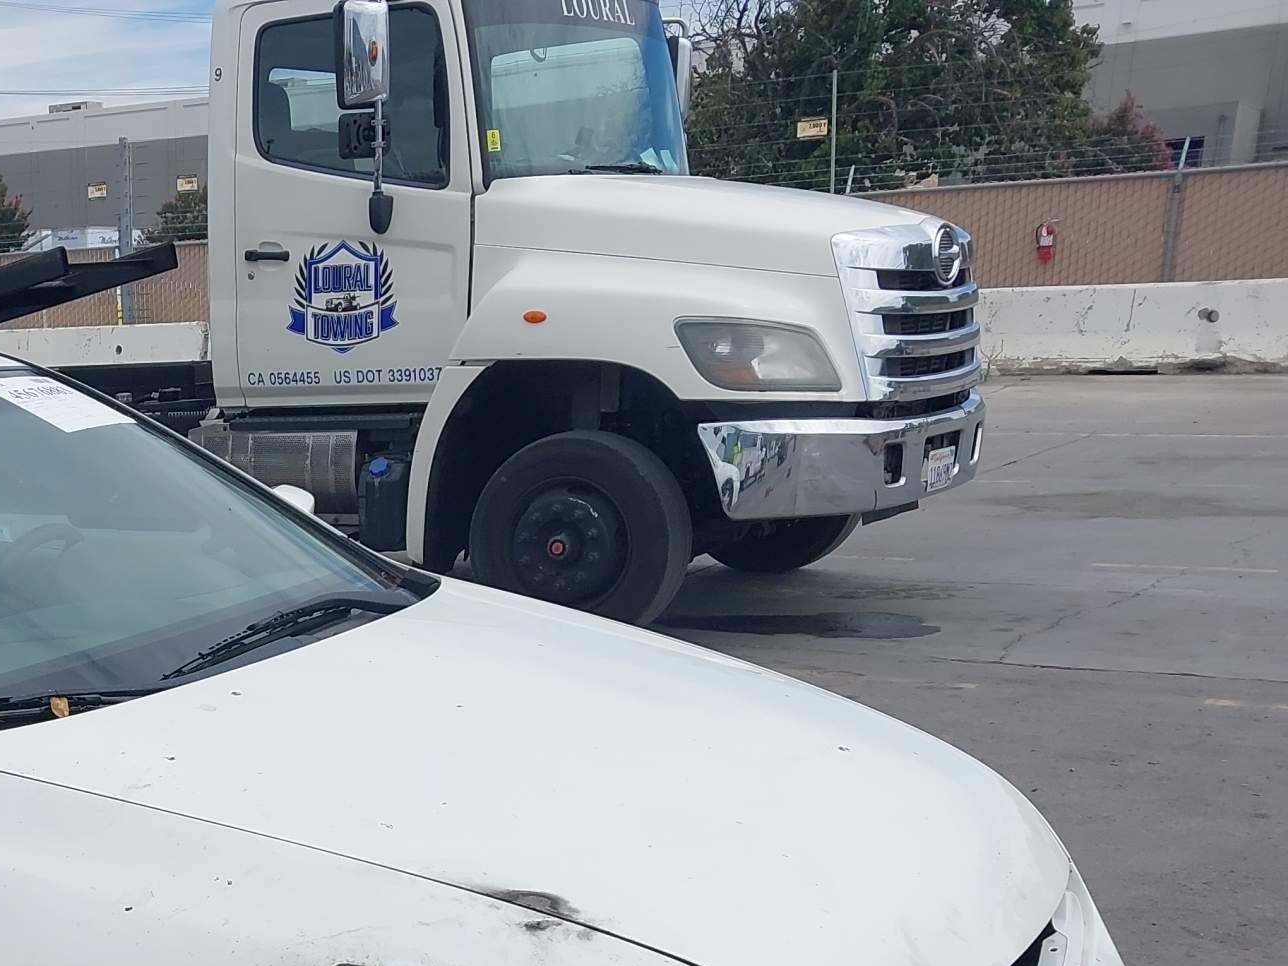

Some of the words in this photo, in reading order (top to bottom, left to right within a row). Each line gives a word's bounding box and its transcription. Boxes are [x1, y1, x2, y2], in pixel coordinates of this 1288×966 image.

[561, 0, 636, 25] LOURAL
[214, 67, 222, 82] 9
[313, 263, 373, 294] LOURAL
[312, 310, 374, 341] TOWING
[247, 371, 265, 386] CA
[269, 371, 321, 386] 0564455
[334, 369, 352, 384] US
[356, 369, 383, 384] DOT
[388, 367, 443, 383] 3391037
